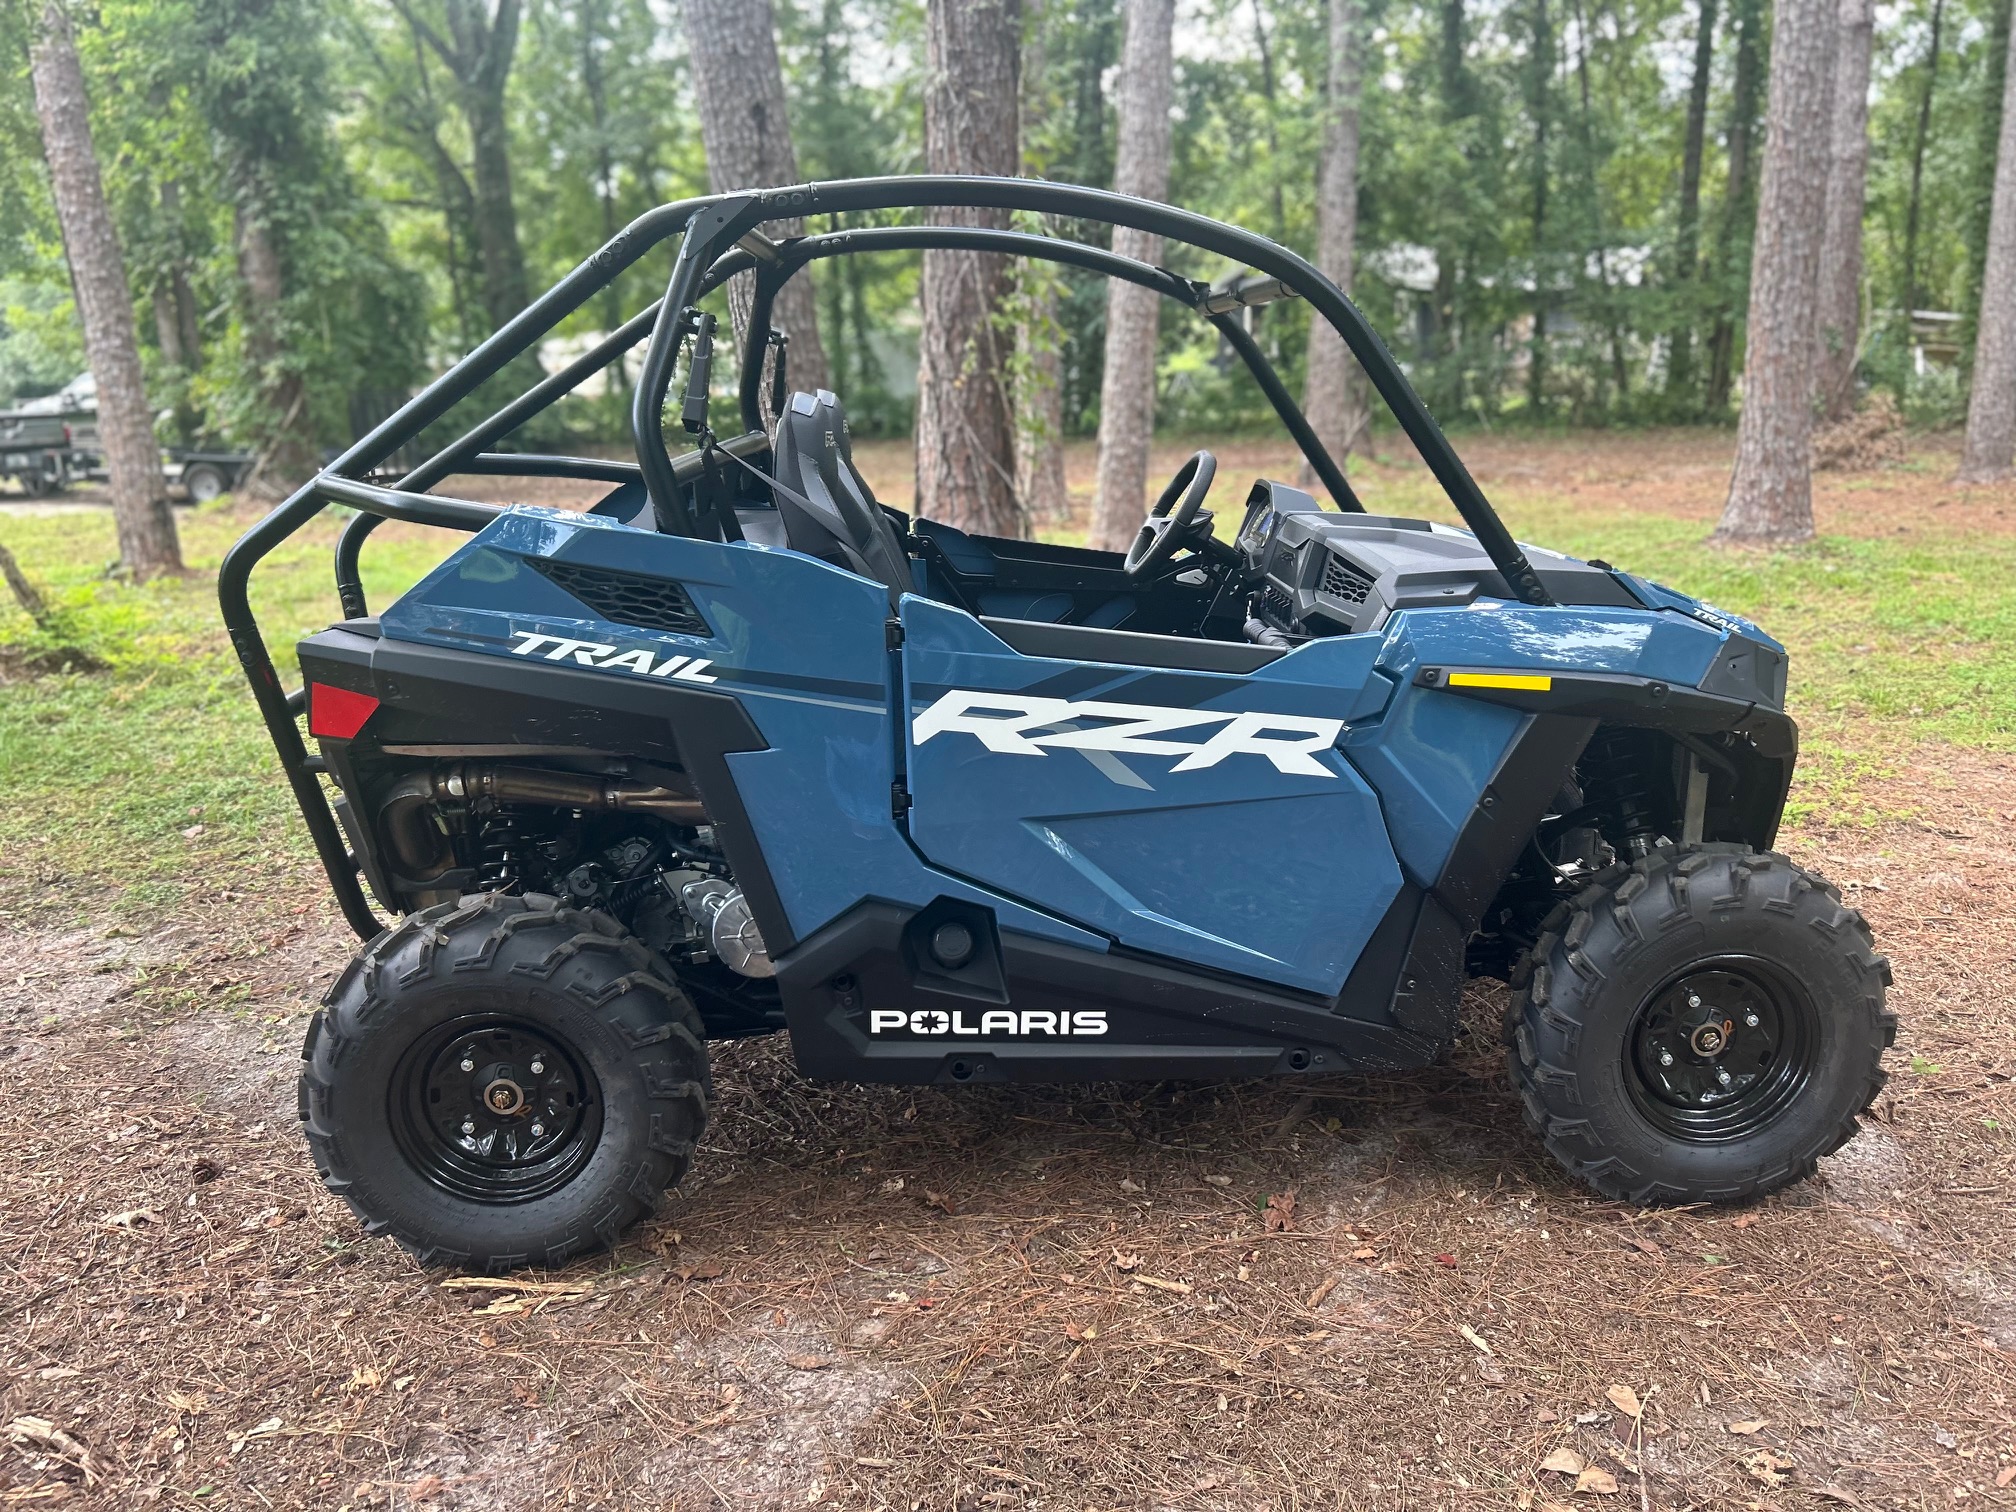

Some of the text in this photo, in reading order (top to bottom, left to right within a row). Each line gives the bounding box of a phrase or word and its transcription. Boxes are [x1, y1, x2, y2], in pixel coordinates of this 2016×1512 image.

[1693, 607, 1742, 634] TRAIL
[511, 630, 719, 684] TRAIL
[912, 689, 1345, 778] RZR
[870, 1009, 1109, 1035] POLARIS
